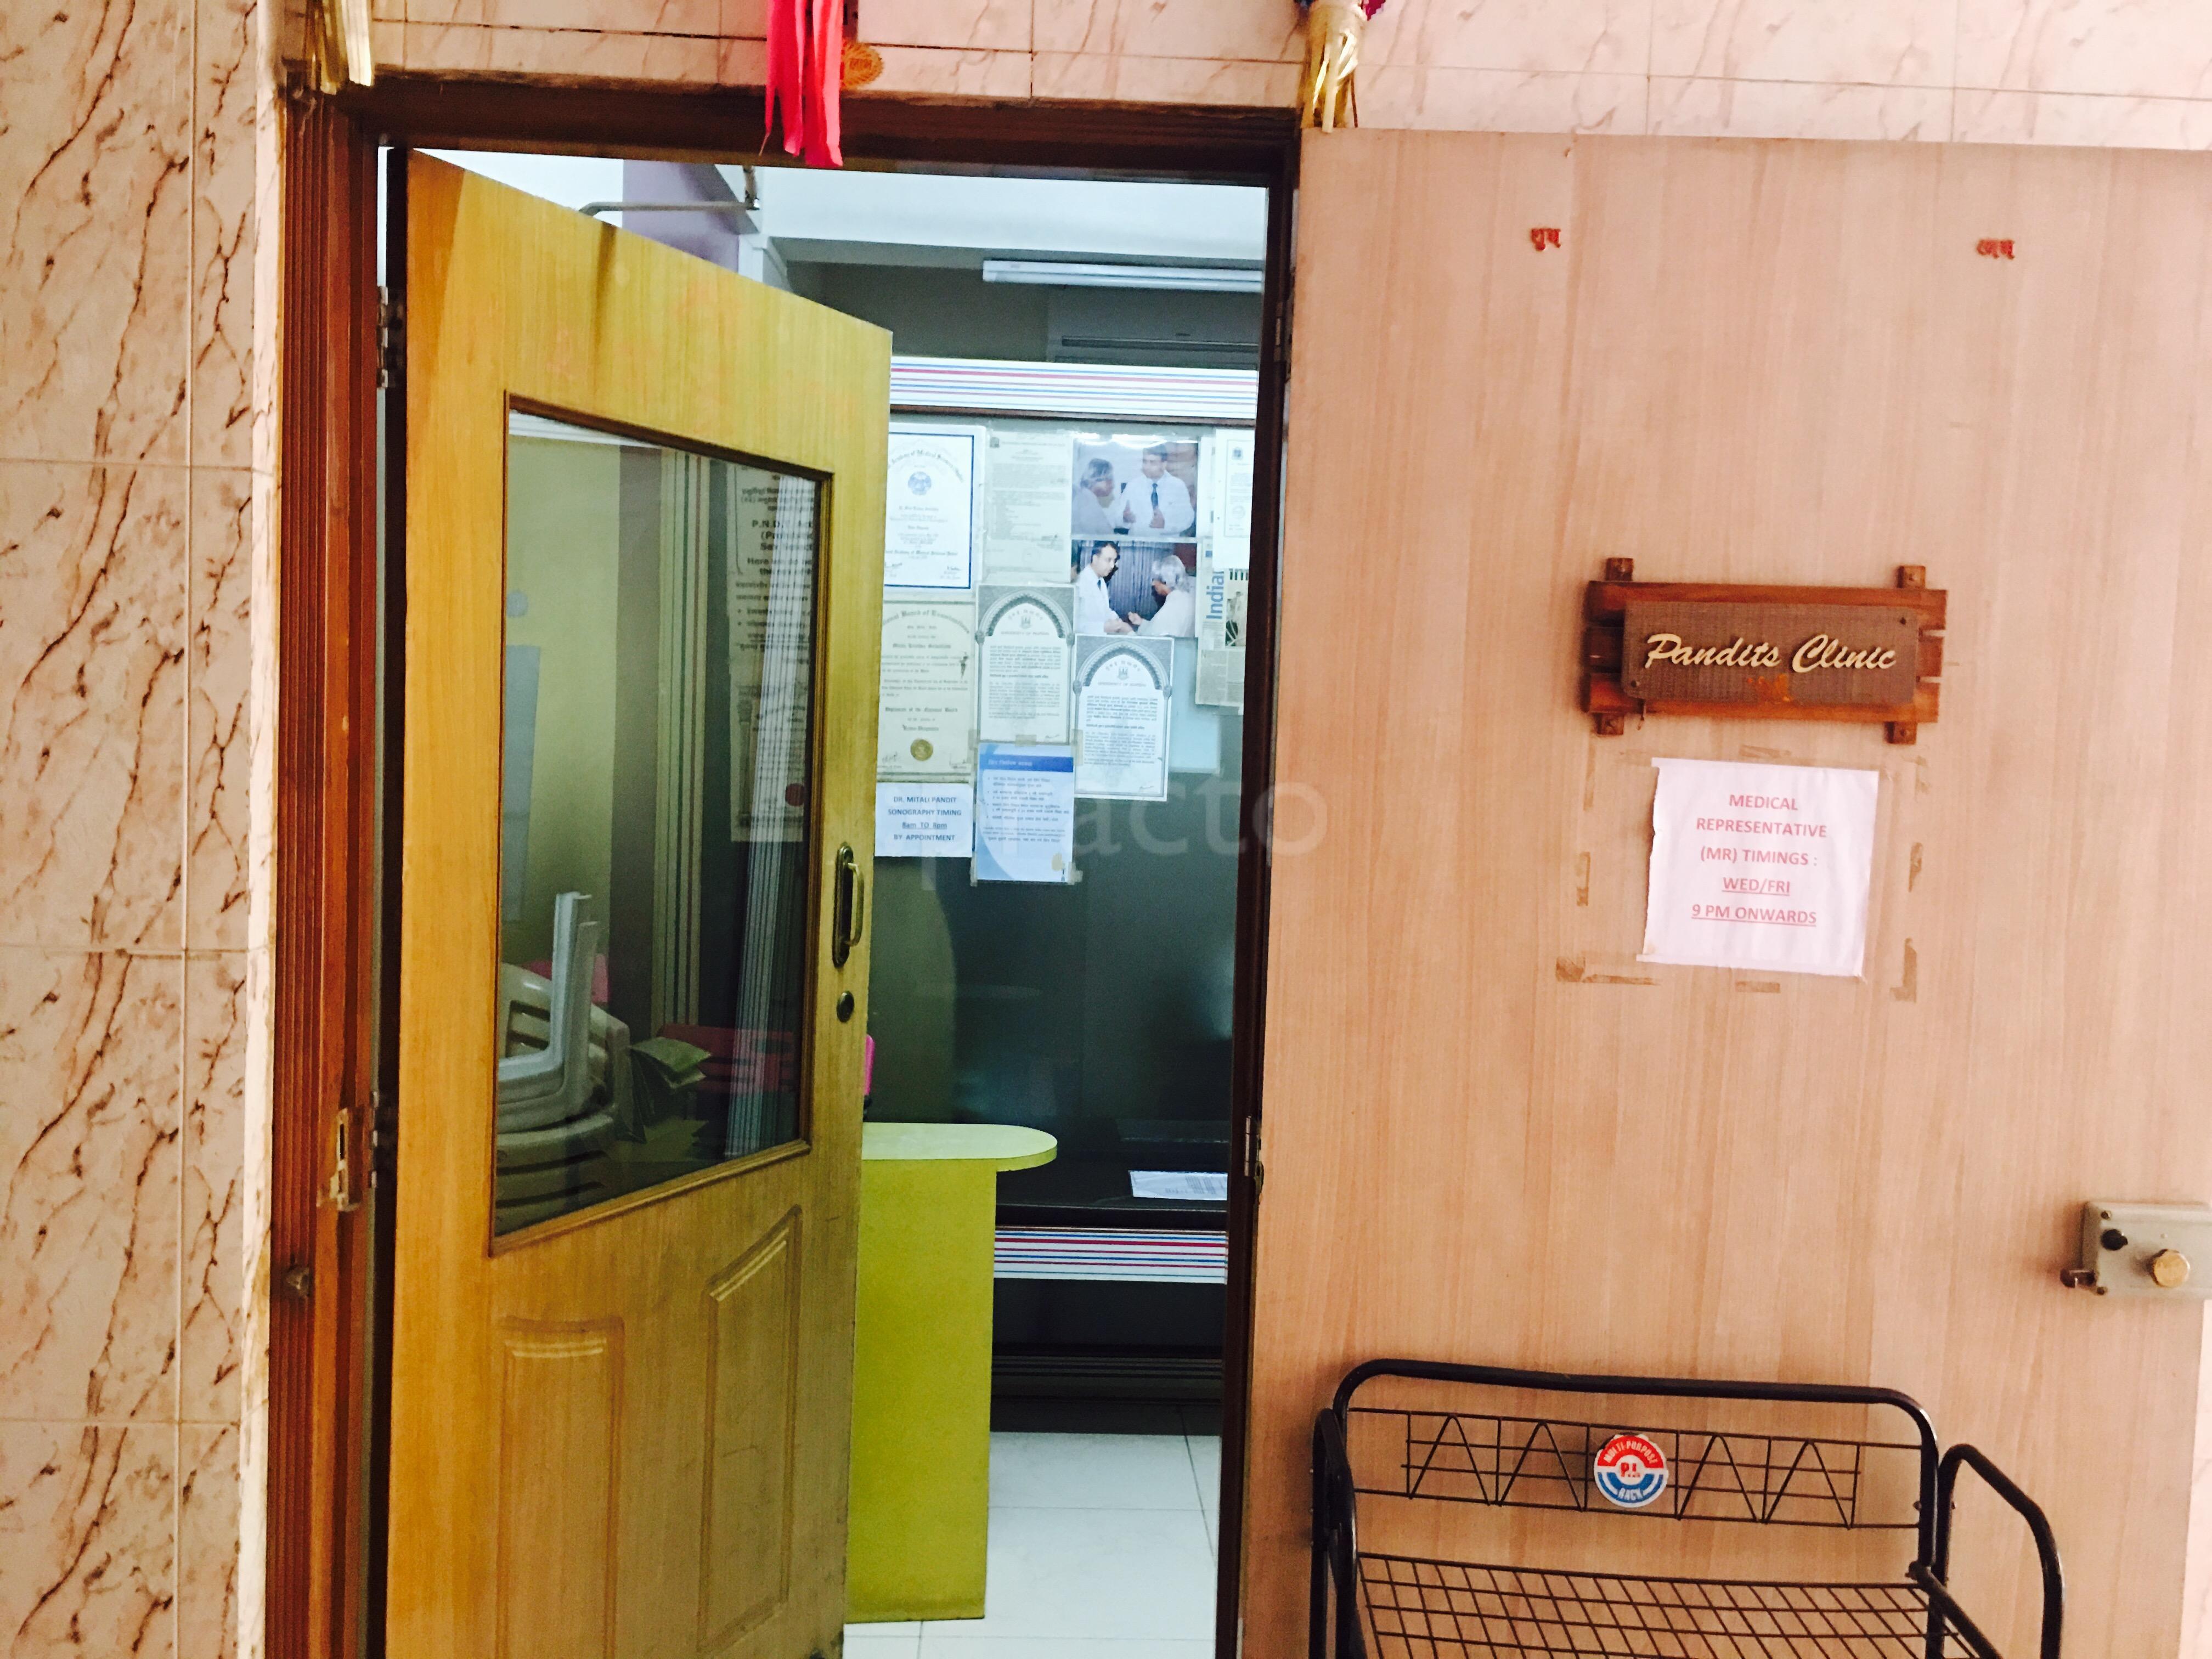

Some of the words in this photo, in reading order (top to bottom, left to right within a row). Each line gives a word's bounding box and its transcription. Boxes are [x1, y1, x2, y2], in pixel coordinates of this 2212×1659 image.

[1645, 633, 1782, 669] Pandits
[1792, 634, 1897, 673] Clinic
[1729, 794, 1799, 811] MEDICAL
[1696, 817, 1827, 838] REPRESENTATIVE
[1701, 846, 1738, 864] (MR)
[1742, 849, 1809, 866] TIMINGS
[1722, 877, 1791, 894] WED/FRI
[1691, 904, 1701, 917] 9
[1706, 905, 1730, 919] PM
[1735, 907, 1817, 924] ONWARDS
[1618, 1487, 1644, 1501] RACK
